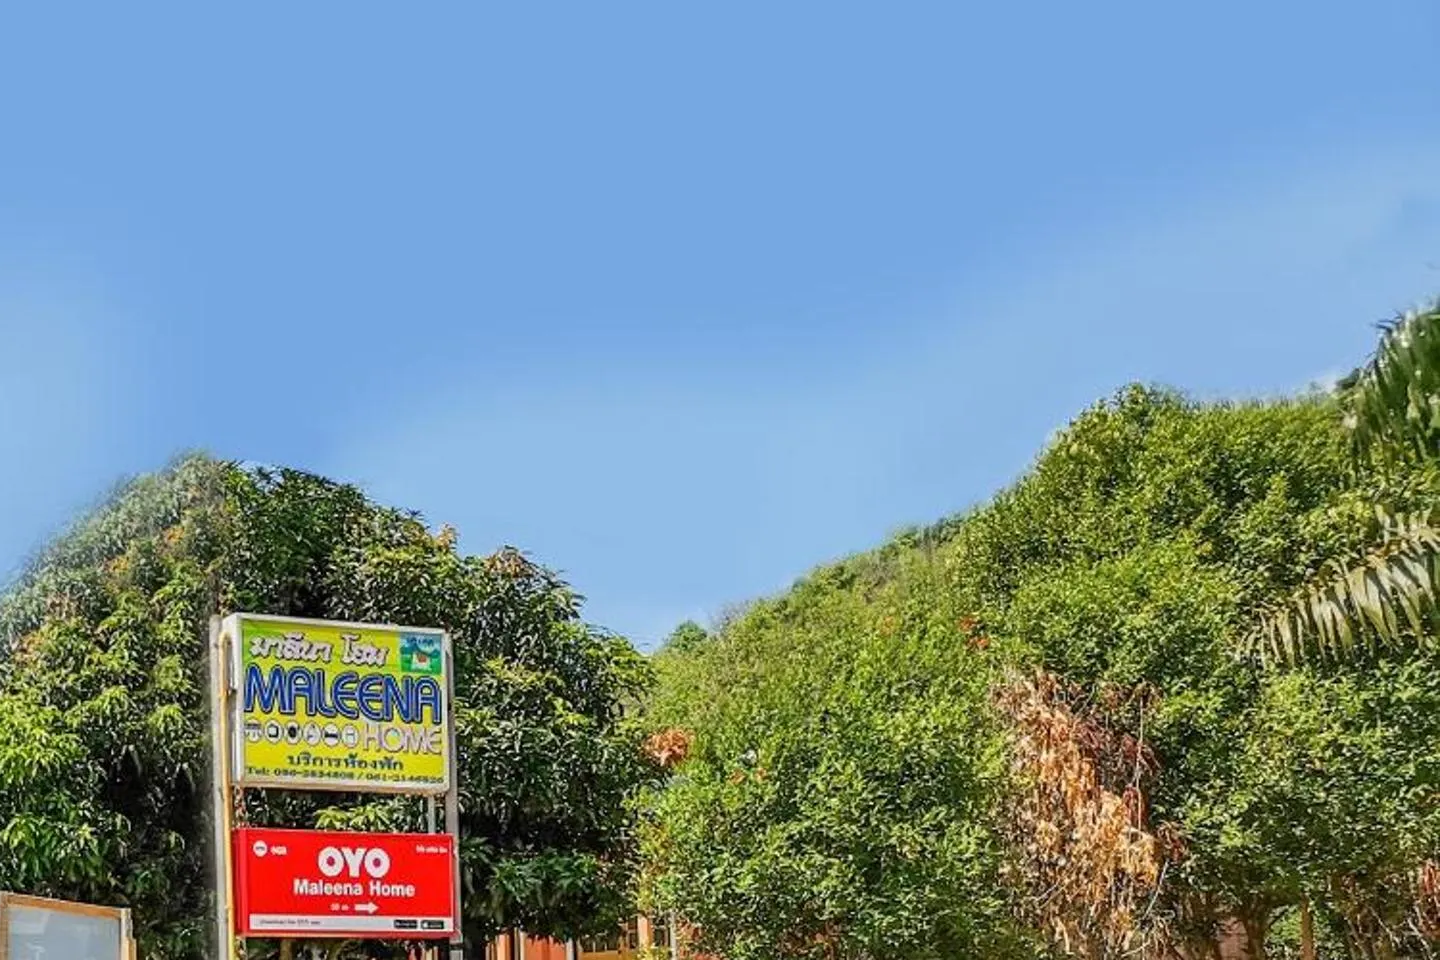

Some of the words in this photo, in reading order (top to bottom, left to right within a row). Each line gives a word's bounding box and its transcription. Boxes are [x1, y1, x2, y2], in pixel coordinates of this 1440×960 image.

[243, 662, 443, 725] MALEENA
[363, 722, 443, 757] HOME
[317, 846, 390, 878] OYO
[293, 878, 363, 896] Maleena
[369, 882, 416, 898] Home
